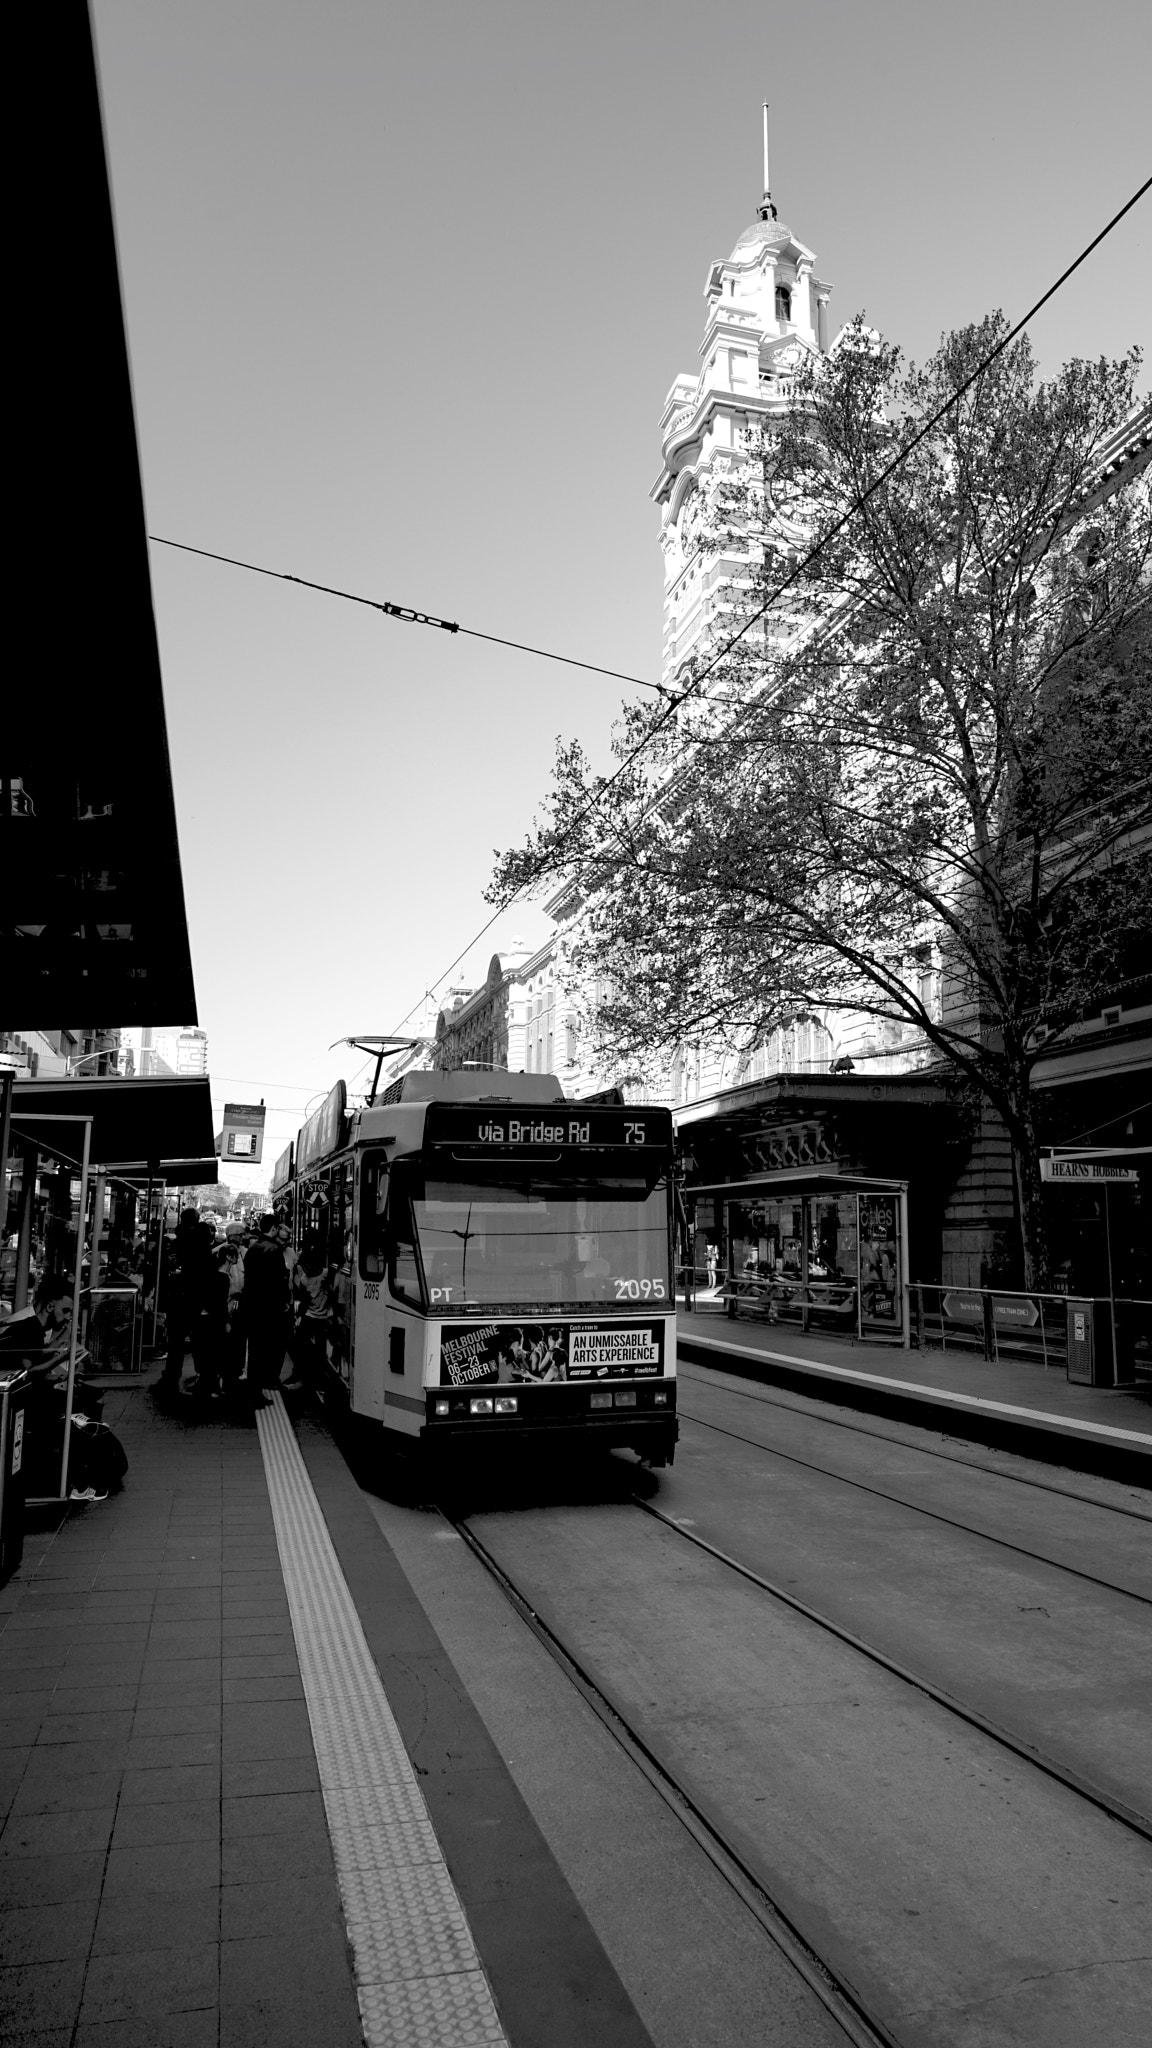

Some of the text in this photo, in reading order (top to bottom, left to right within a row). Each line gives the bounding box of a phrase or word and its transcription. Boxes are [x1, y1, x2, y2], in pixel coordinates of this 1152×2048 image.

[478, 1120, 590, 1143] via Bridge Rd
[624, 1122, 645, 1144] 75
[1051, 1162, 1129, 1178] HEARNS HOBBIES
[308, 1183, 329, 1192] STOP
[362, 1282, 380, 1301] 2095
[430, 1287, 453, 1303] PT
[614, 1278, 665, 1299] 2095
[441, 1324, 500, 1355] MELBOURNE
[573, 1333, 648, 1349] AN UNMISSABLE
[444, 1340, 489, 1365] FESTIVAL
[573, 1347, 655, 1363] ARTS EXPERIENCE
[451, 1363, 491, 1386] OCTOBER
